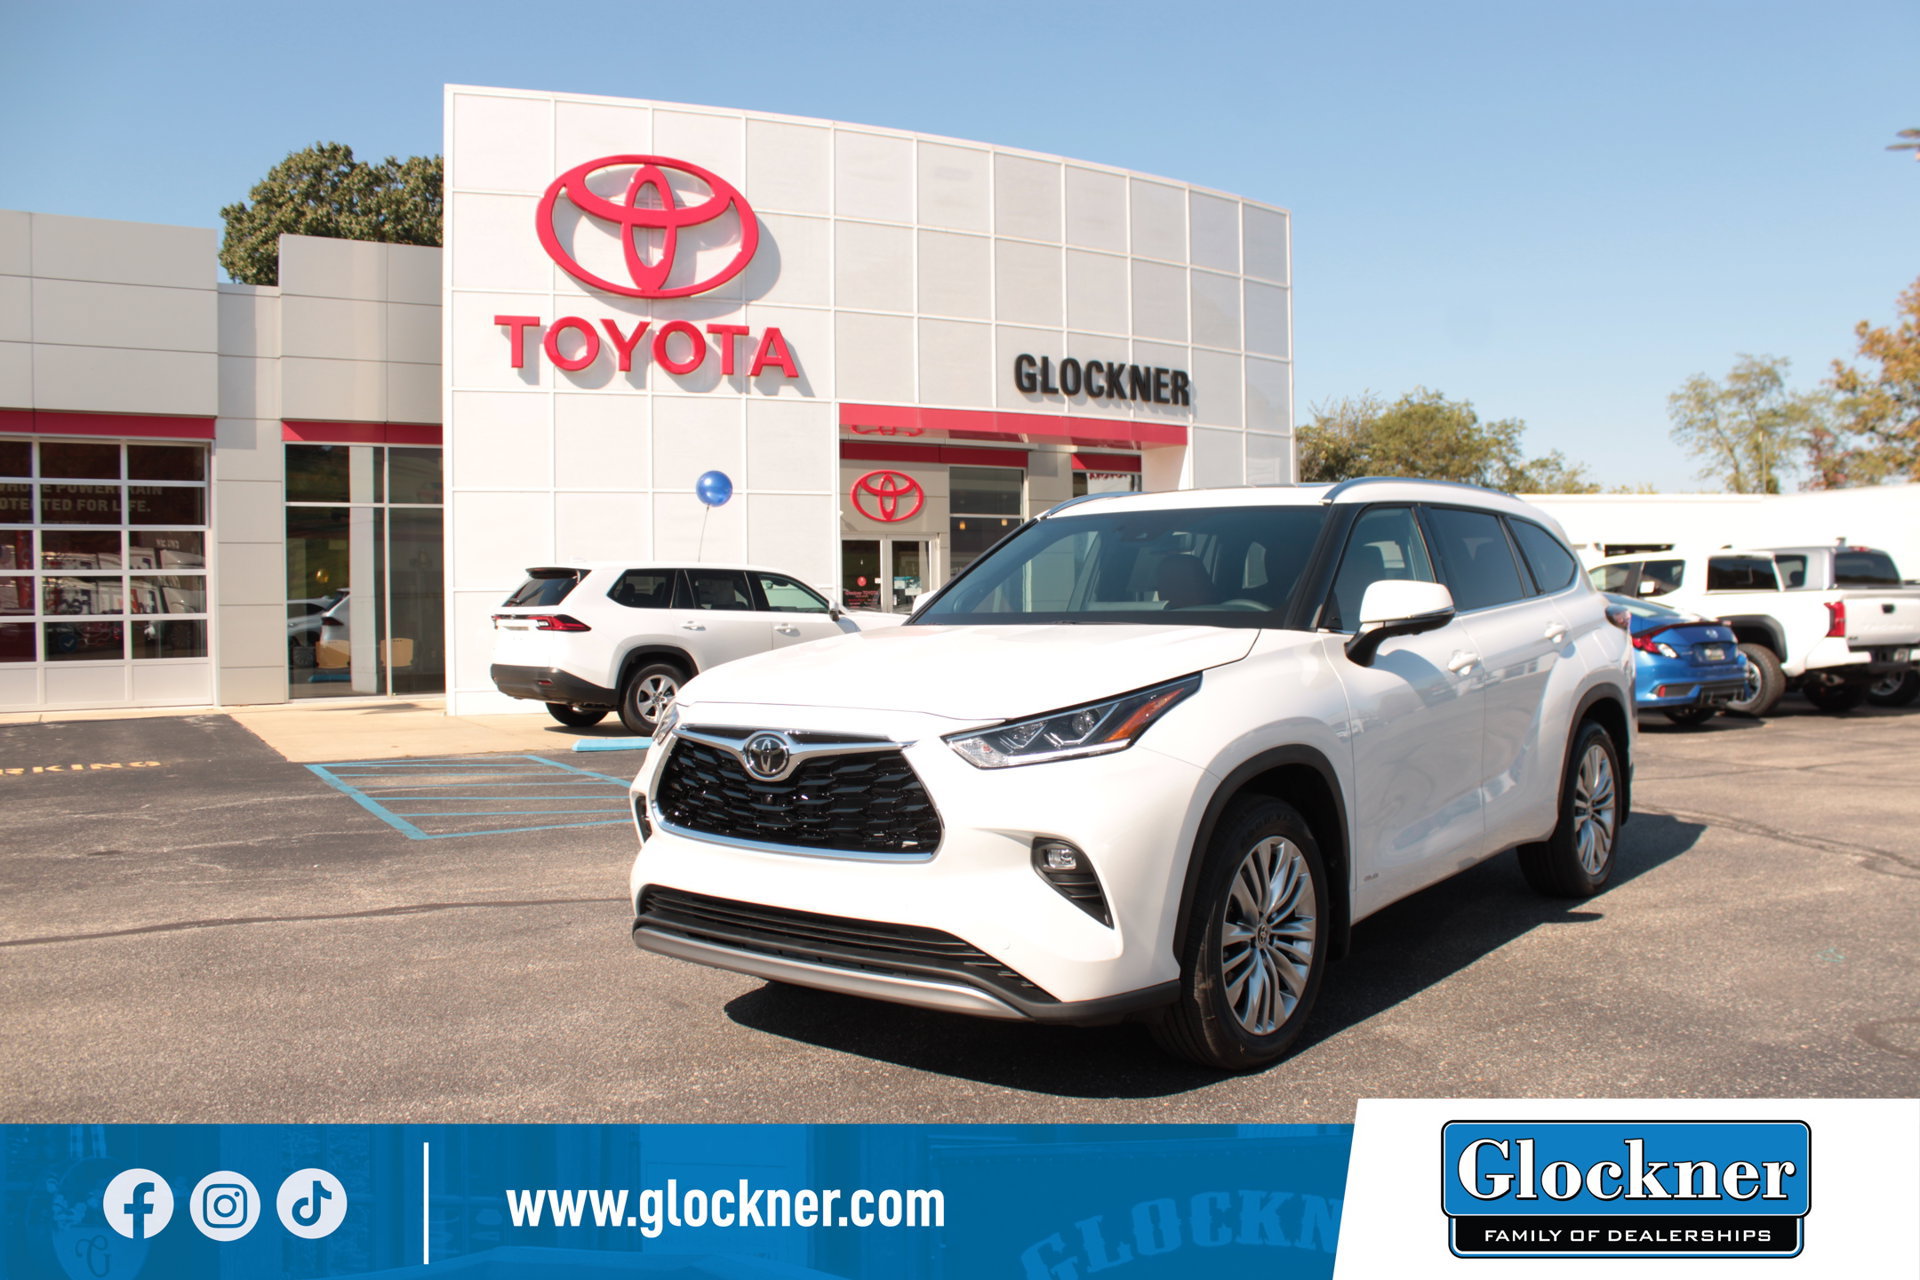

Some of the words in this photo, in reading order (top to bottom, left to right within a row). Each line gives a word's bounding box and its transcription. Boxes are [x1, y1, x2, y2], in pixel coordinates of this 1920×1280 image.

[494, 314, 799, 378] TOYOTA
[1014, 353, 1191, 407] GLOCKNER
[0, 498, 72, 512] OTETED
[76, 499, 108, 512] FOR
[112, 500, 151, 512] LFE.
[0, 761, 161, 776] RKING
